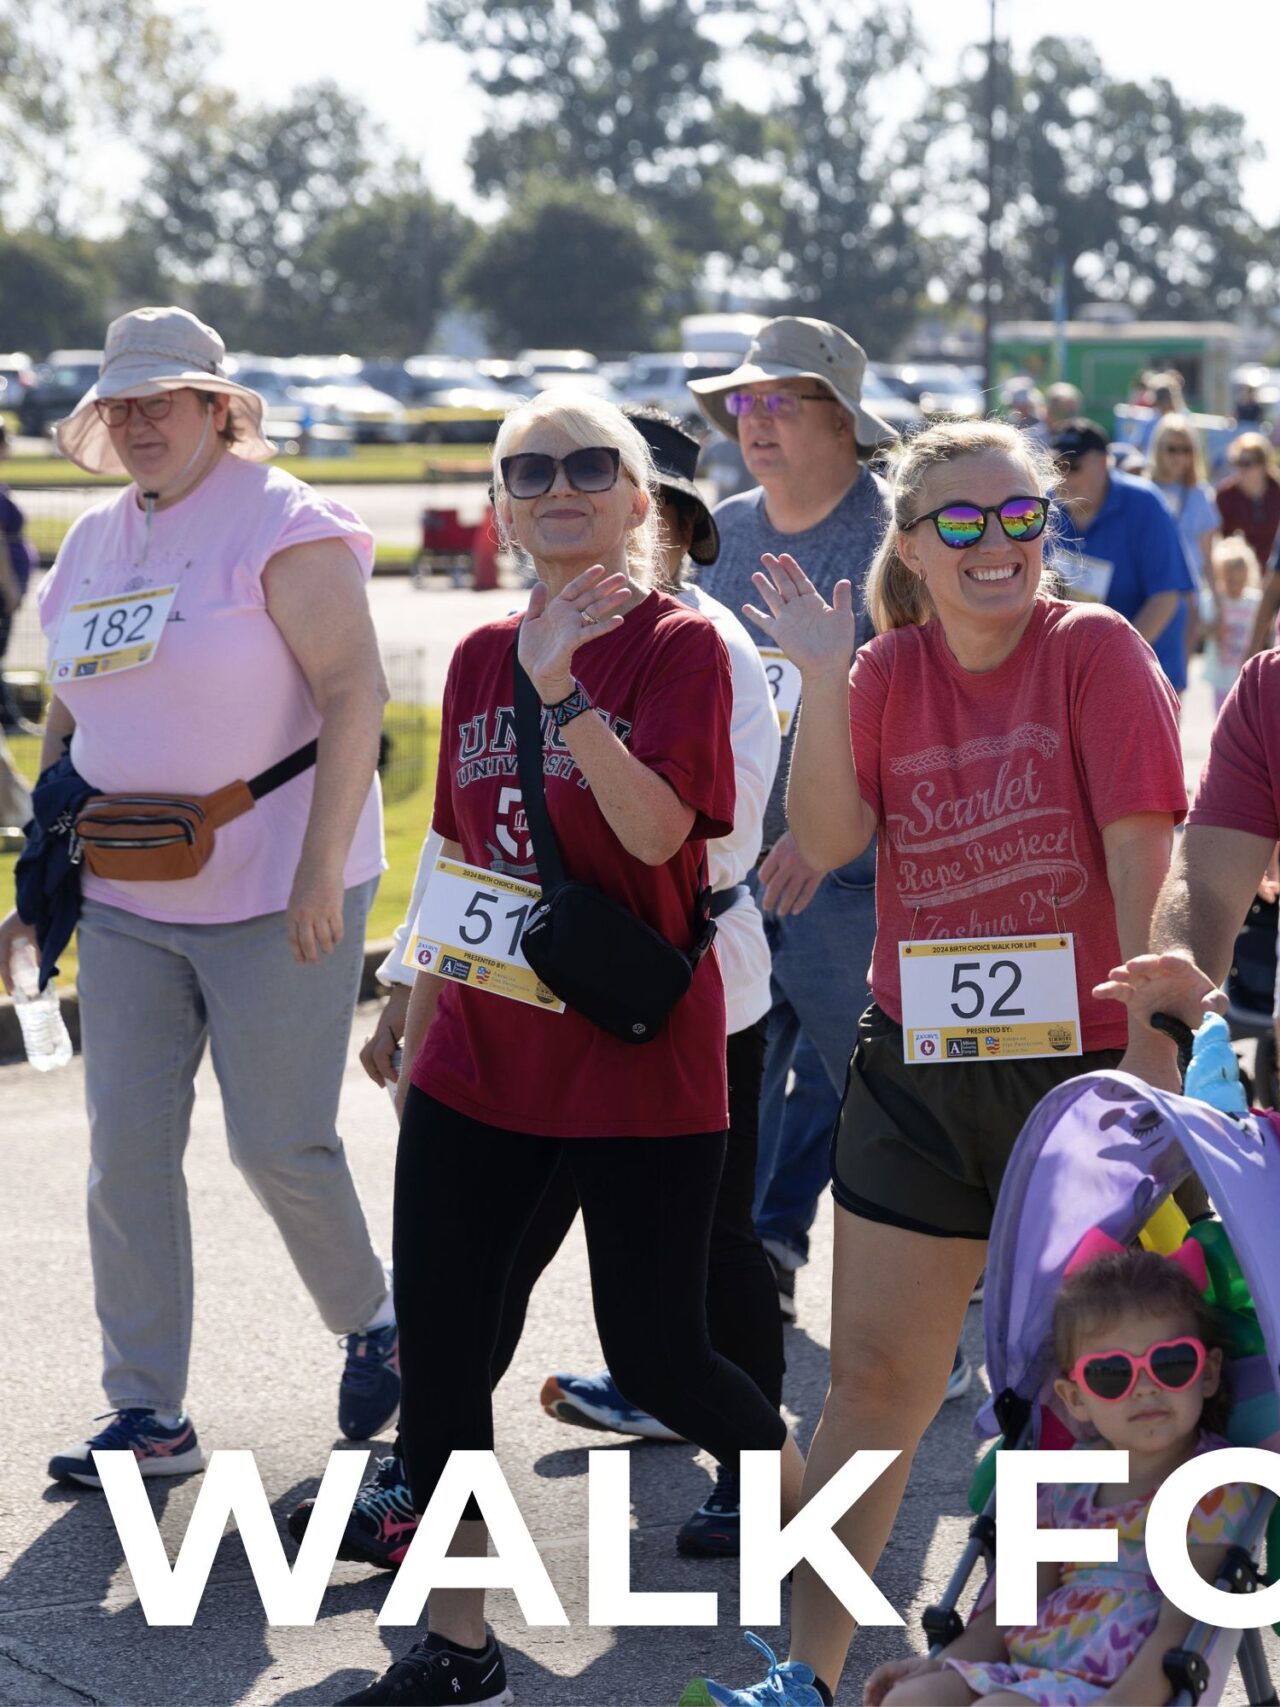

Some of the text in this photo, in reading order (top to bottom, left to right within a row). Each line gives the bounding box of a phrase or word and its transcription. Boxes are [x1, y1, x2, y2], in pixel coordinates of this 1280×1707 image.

[83, 604, 153, 651] 182
[456, 754, 590, 789] UNIVSIT
[906, 758, 1041, 836] Scarlet
[896, 827, 1068, 892] Rope Project
[463, 869, 477, 878] 2024
[477, 873, 493, 883] BIRTH
[493, 878, 514, 890] CHOICE
[514, 884, 533, 896] WALK
[458, 891, 529, 957] 51
[464, 952, 507, 971] PRESENTED BY:
[1024, 941, 1037, 949] LIFE
[950, 960, 1026, 1019] 52
[966, 1026, 1000, 1035] PRESENTED
